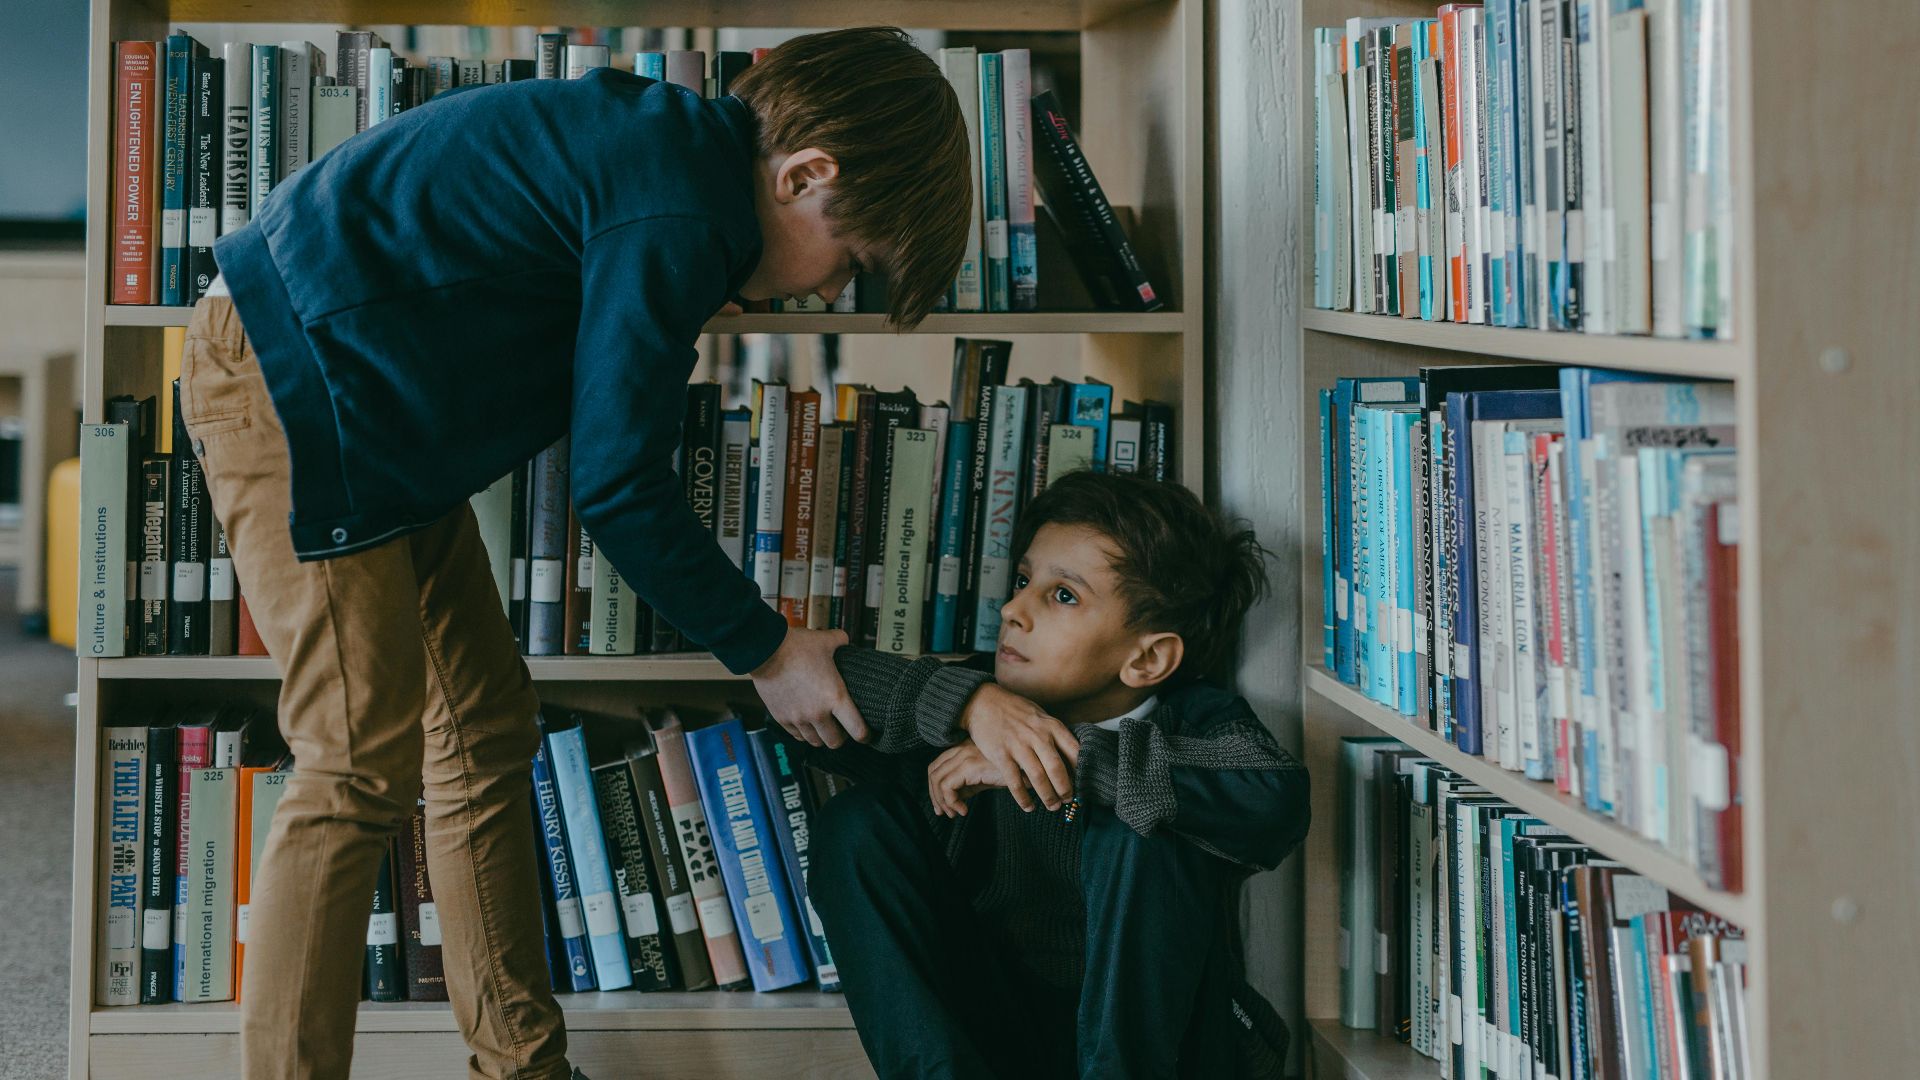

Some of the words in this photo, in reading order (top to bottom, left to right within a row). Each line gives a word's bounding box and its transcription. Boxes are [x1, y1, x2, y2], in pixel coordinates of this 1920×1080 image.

[1384, 46, 1392, 94] Principles
[168, 77, 178, 144] TWENTY-FIRST
[201, 72, 211, 117] Sims/Lorenzi
[319, 88, 350, 98] 303.4
[1015, 80, 1026, 131] MARRIED
[1384, 95, 1392, 106] of
[129, 82, 142, 171] ENLIGHTENED
[177, 93, 188, 149] LEADERSHIP
[200, 134, 211, 150] The
[257, 106, 271, 146] VALUES
[289, 87, 301, 153] LEADERSHIP
[1382, 108, 1393, 157] Budgetary
[166, 147, 177, 191] CENTURY
[200, 152, 210, 170] New
[226, 105, 248, 210] LEADERSHIP
[257, 147, 270, 166] and
[288, 155, 300, 168] IN
[1016, 144, 1026, 178] SINGLE
[1071, 156, 1092, 184] black
[1385, 159, 1393, 182] and
[127, 175, 139, 221] POWER
[199, 171, 210, 208] Leadershi
[767, 396, 777, 440] GETTING
[802, 402, 817, 448] WOMEN
[979, 386, 992, 421] MARTIN
[94, 428, 115, 437] 306
[906, 431, 927, 442] 323
[976, 422, 989, 453] LUTHER
[1061, 428, 1082, 440] 324
[182, 460, 191, 470] in
[191, 459, 201, 495] Political
[765, 444, 776, 488] AMERICA
[181, 470, 191, 508] America
[722, 443, 743, 538] LIBERTARIANISM
[763, 490, 775, 521] RIGHT
[797, 468, 813, 520] POLITICS
[853, 480, 865, 528] WOMEN
[989, 469, 1016, 538] KING
[1377, 465, 1385, 511] HISTORY
[144, 501, 164, 562] Megatre
[190, 497, 200, 562] Communicatio
[900, 507, 915, 547] rights
[1378, 514, 1385, 529] OF
[1421, 433, 1433, 631] MICROECONOMICS
[1448, 429, 1459, 612] MICROECONOMICS
[94, 506, 107, 585] institutions
[1509, 523, 1524, 608] MANAGERIAL
[606, 569, 619, 595] scie
[897, 550, 910, 604] political
[1378, 538, 1386, 599] AMERICAN
[1443, 488, 1455, 679] MICROECONOMICS
[94, 588, 106, 600] &
[893, 607, 906, 618] &
[93, 603, 105, 654] Culture
[606, 598, 618, 653] Political
[892, 623, 905, 652] Civil
[1515, 618, 1528, 653] ECON
[109, 738, 147, 754] Reichley
[113, 758, 141, 797] THE
[153, 777, 163, 815] WHISTLE
[203, 772, 224, 782] 325
[266, 774, 286, 786] 327
[781, 782, 803, 810] The
[112, 799, 139, 843] LIFE
[153, 816, 162, 837] STOP
[537, 779, 562, 839] HENRY
[605, 771, 630, 849] AMERICAN
[647, 789, 660, 820] AMERICAN
[654, 820, 669, 856] DIPLOMACY
[412, 813, 424, 862] American
[678, 818, 706, 883] PEACE
[693, 820, 720, 880] LONG
[730, 817, 758, 850] AND
[1456, 817, 1464, 884] BEYOND
[112, 844, 125, 874] THE
[124, 849, 136, 866] OF
[152, 847, 162, 875] SOUND
[202, 841, 216, 907] migration
[549, 845, 573, 900] KISSIN
[615, 769, 641, 848] FRANKLIN
[631, 848, 642, 859] D.
[651, 950, 666, 979] AND
[151, 876, 161, 897] BITE
[414, 864, 428, 899] People
[1415, 877, 1421, 888] &
[199, 911, 213, 998] International
[1415, 892, 1423, 976] enterprises
[111, 979, 128, 987] FREE
[1520, 934, 1528, 998] ECONOMIC
[110, 988, 131, 996] PRESS
